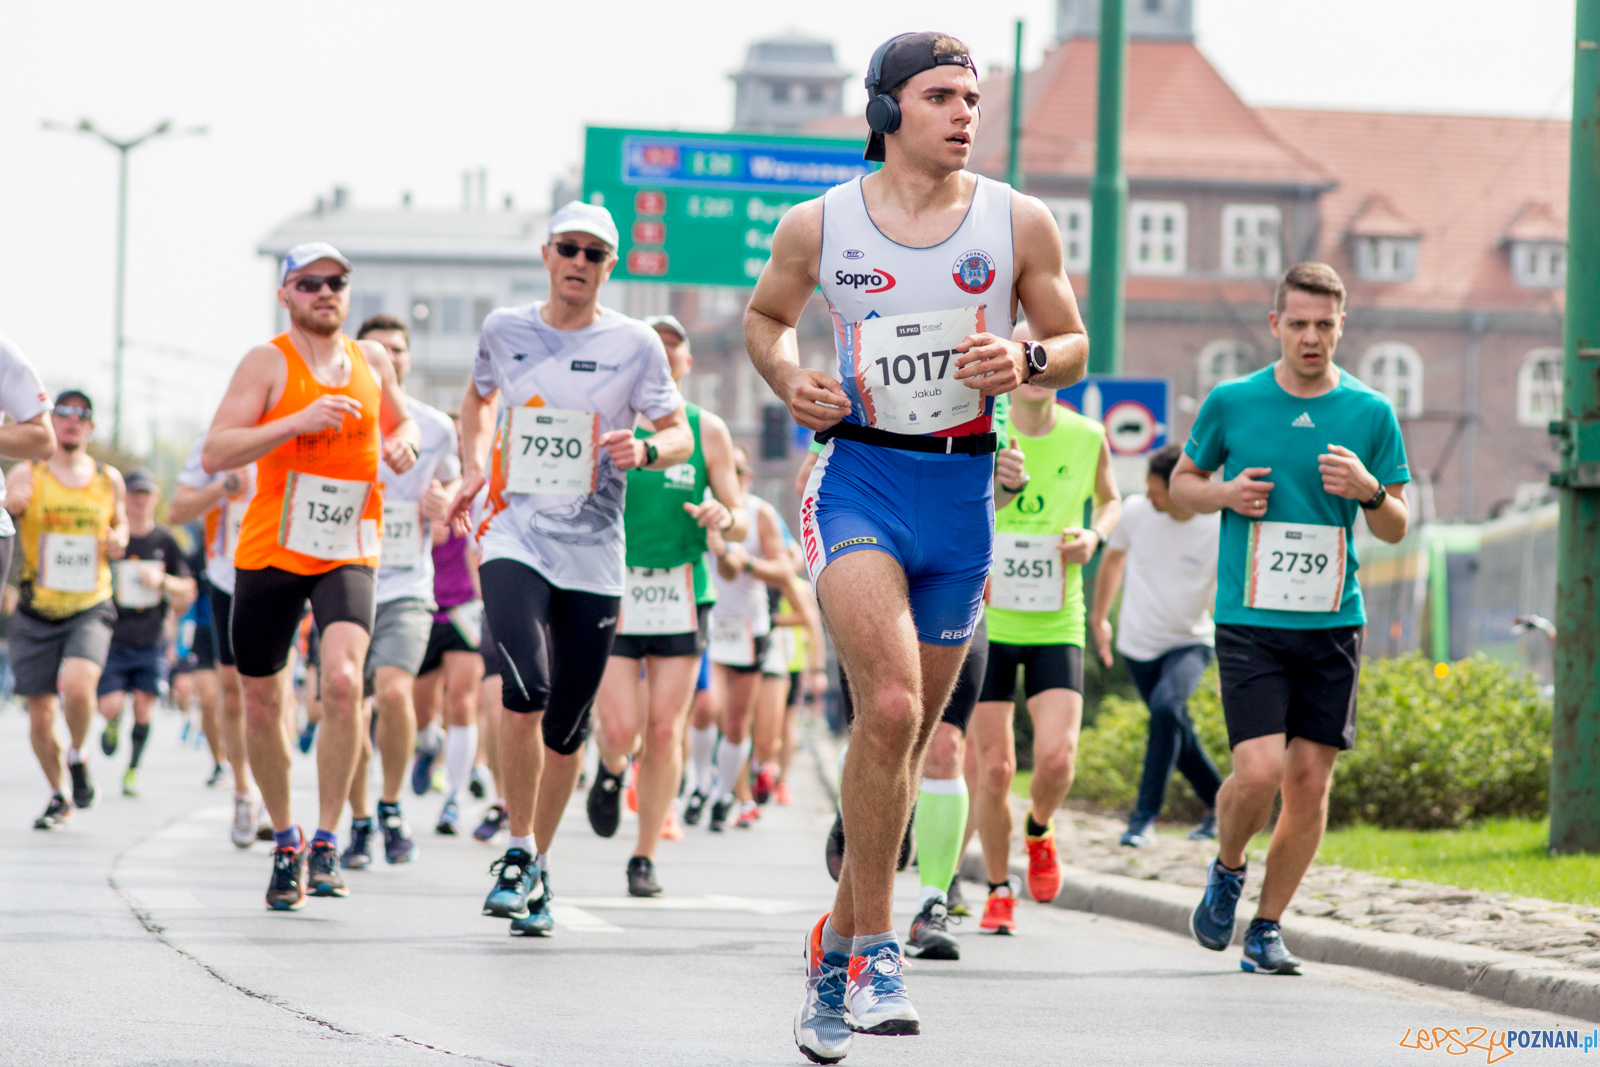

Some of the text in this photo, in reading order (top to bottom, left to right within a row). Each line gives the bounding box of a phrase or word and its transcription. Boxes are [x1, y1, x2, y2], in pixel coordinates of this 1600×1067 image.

[835, 270, 882, 289] Sopro
[912, 388, 942, 399] Jakub
[521, 435, 582, 459] 7930
[308, 501, 355, 525] 1349
[833, 537, 874, 550] amos
[1004, 559, 1052, 578] 3651
[1270, 551, 1328, 574] 2739
[632, 586, 680, 602] 9074
